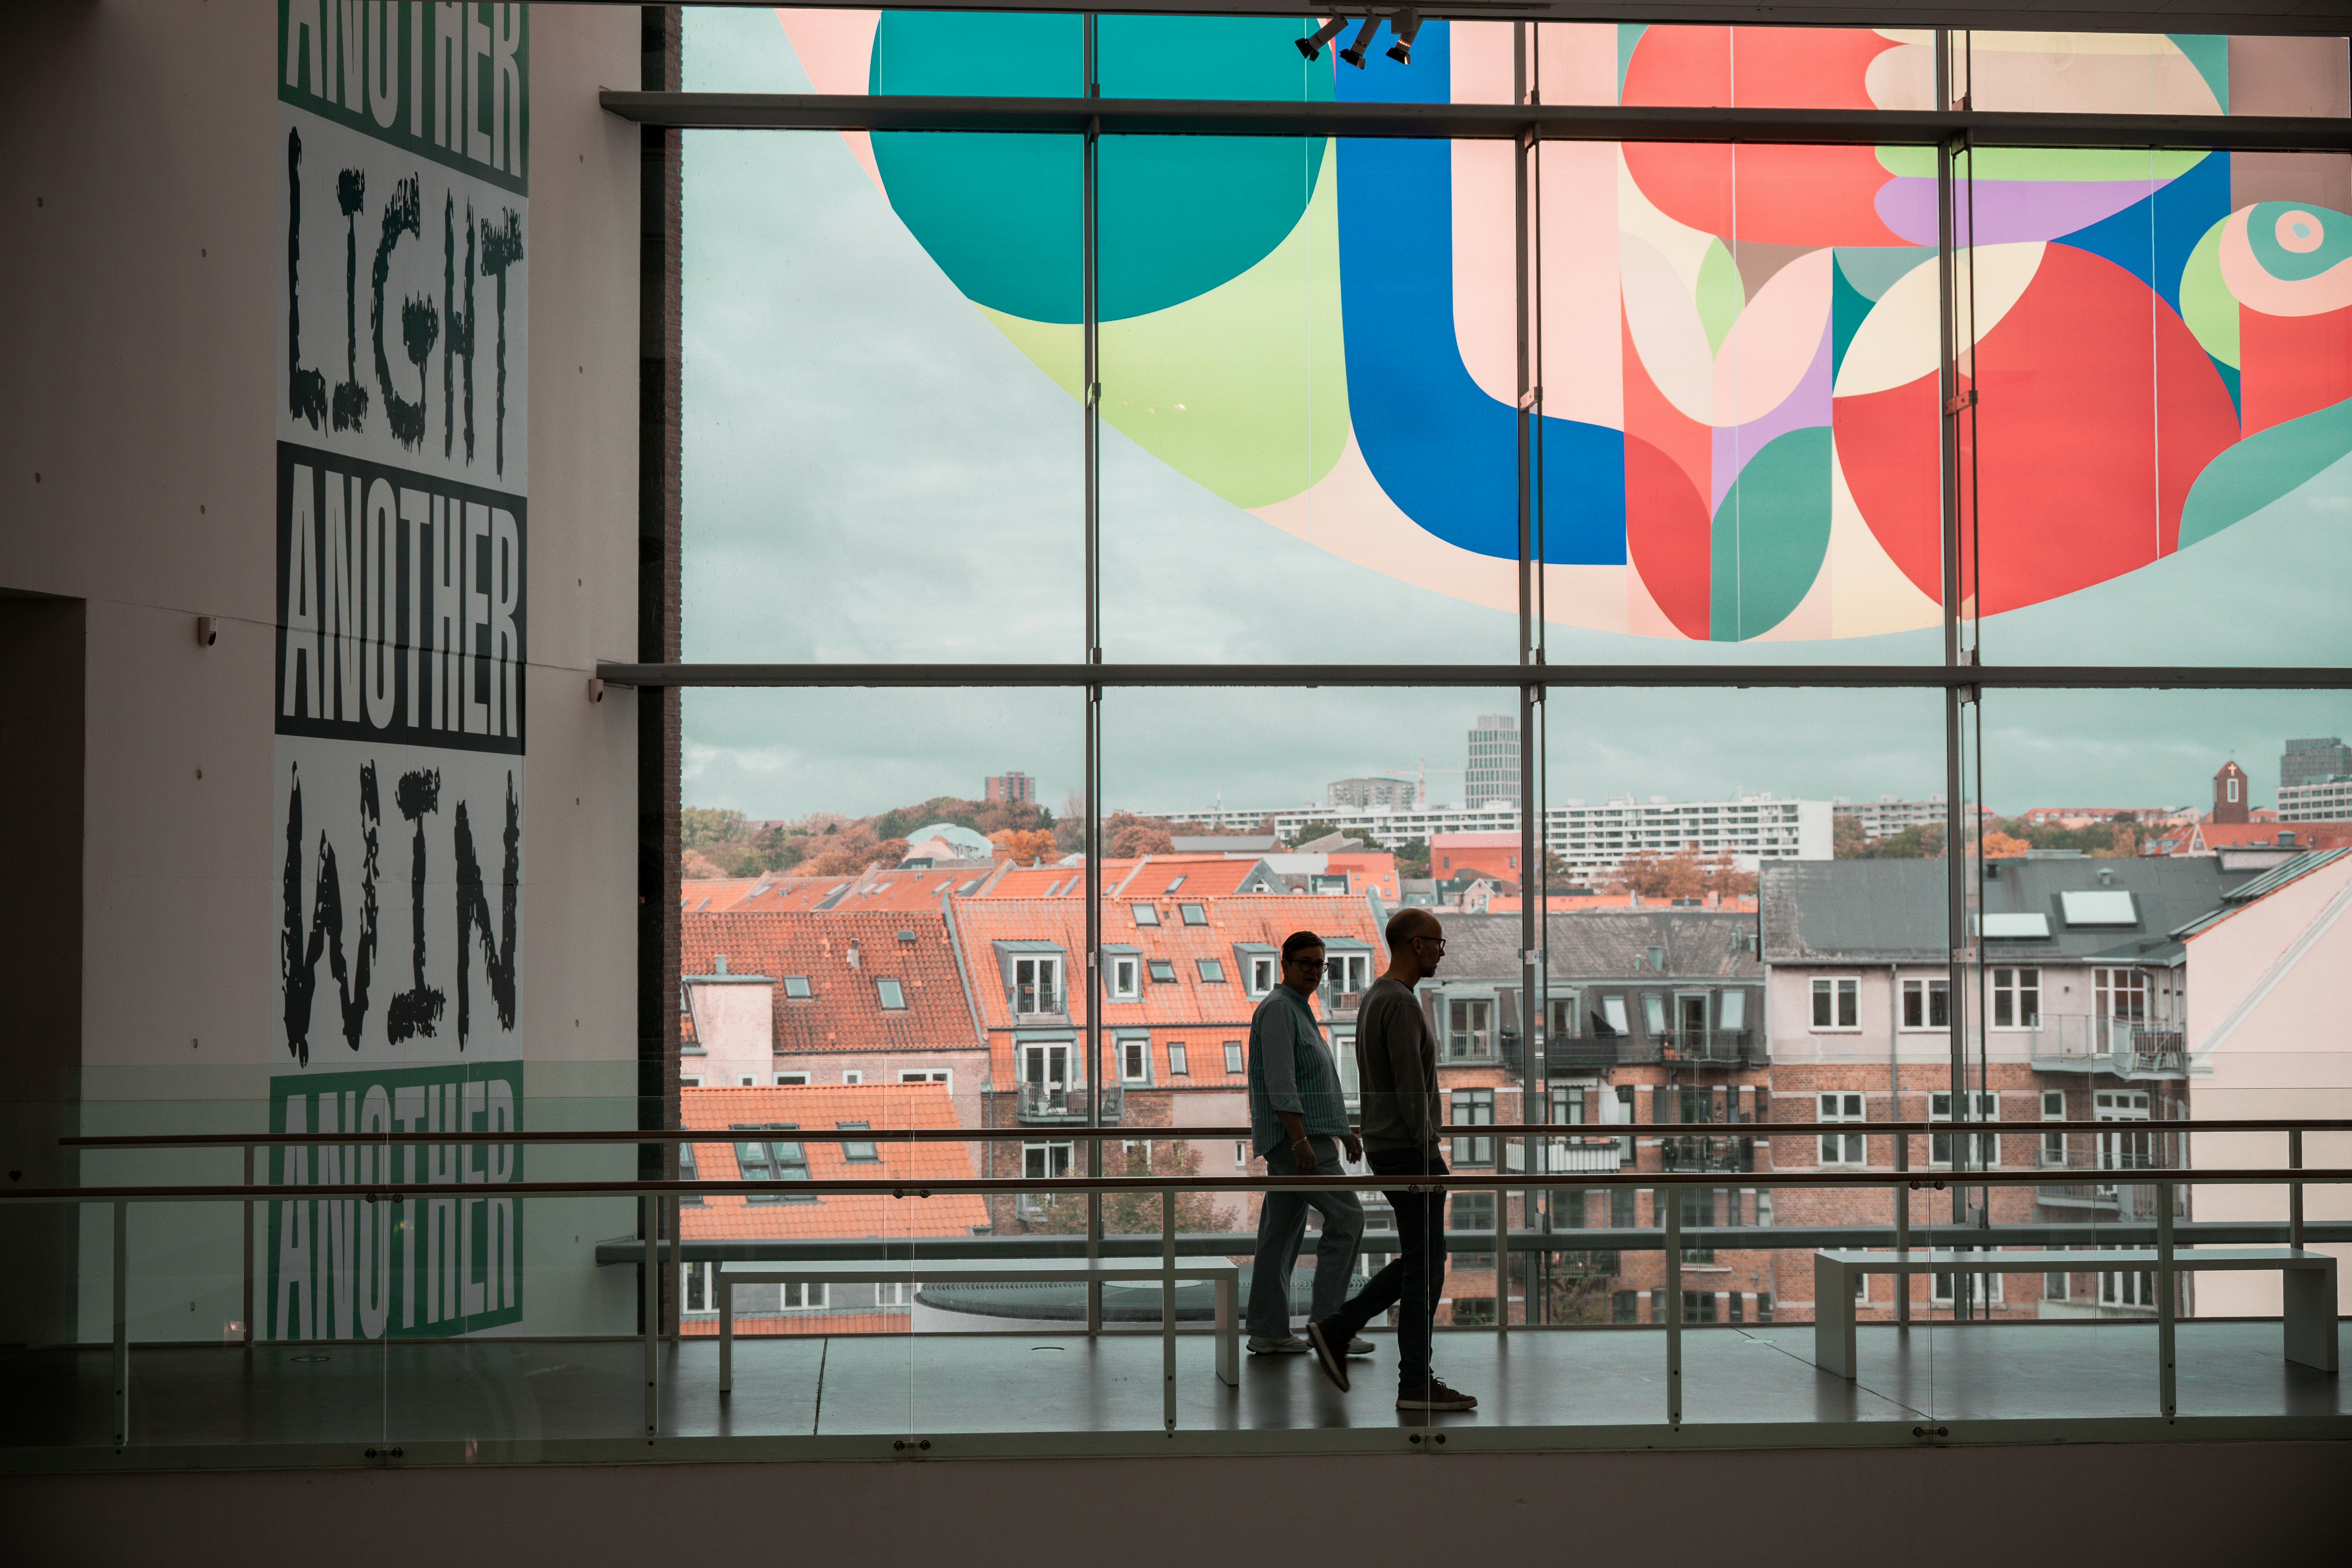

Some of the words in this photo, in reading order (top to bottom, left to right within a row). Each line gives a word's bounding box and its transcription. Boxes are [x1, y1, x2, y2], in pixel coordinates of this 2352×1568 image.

[288, 126, 523, 482] LIGHT
[283, 463, 519, 737] ANOTHER
[281, 759, 520, 1069] WIN
[276, 1079, 515, 1339] ANOTHER
